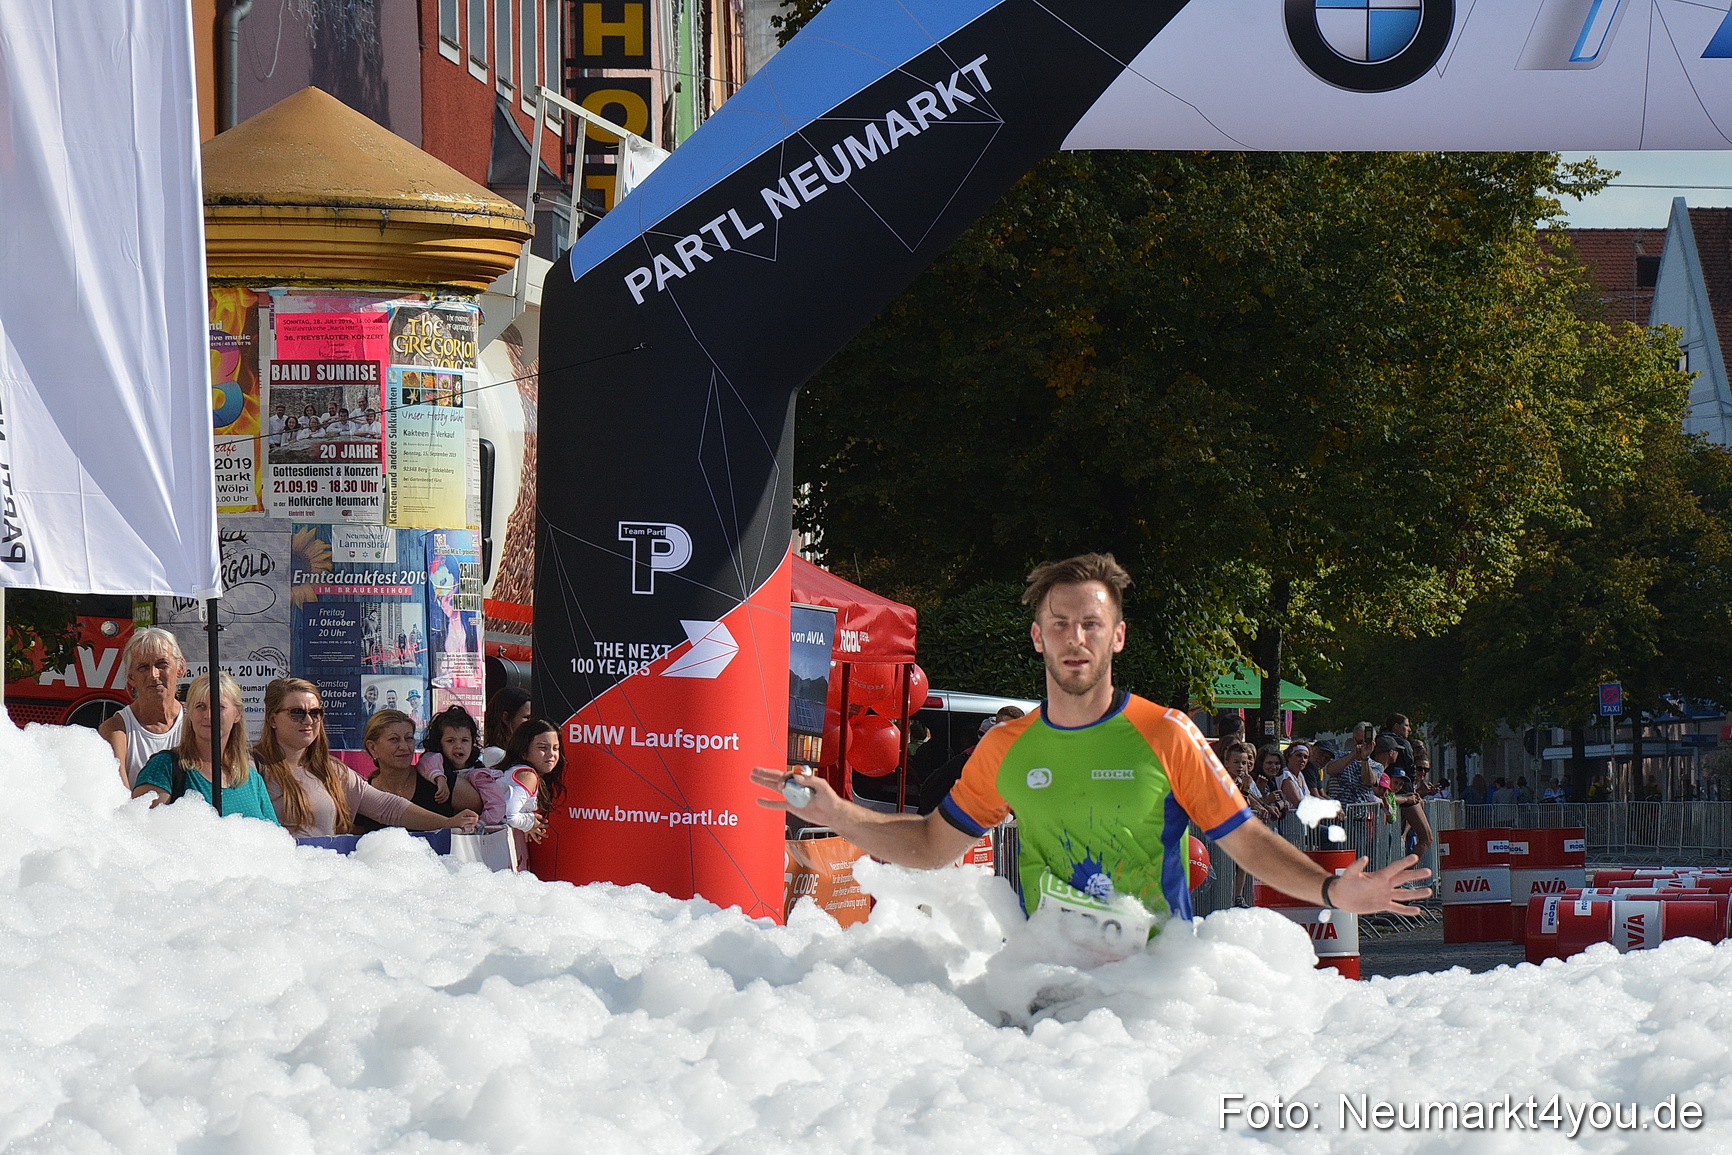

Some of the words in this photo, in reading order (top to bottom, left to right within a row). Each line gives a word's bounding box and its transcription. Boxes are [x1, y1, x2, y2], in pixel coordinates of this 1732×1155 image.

[624, 208, 765, 305] PARTL
[760, 53, 994, 220] NEUMARKT
[271, 364, 310, 381] BAND
[317, 364, 377, 381] SUNRISE
[388, 387, 398, 439] Sukkulenten
[403, 429, 429, 437] Kakteen
[320, 444, 334, 459] 20
[340, 444, 379, 459] JAHRE
[388, 441, 398, 469] andere
[215, 457, 252, 470] 2019
[273, 465, 334, 477] Gottesdienst
[336, 467, 341, 477] &
[344, 465, 379, 477] Konzert
[273, 480, 318, 493] 21.09.19
[329, 480, 358, 493] 18.30
[361, 480, 379, 493] Uhr
[388, 472, 398, 489] und
[217, 483, 249, 494] Wölpi
[288, 496, 333, 507] Hofkirche
[336, 496, 379, 507] Neumarkt
[388, 490, 398, 525] Kakteen
[345, 532, 384, 540] Neumarkter
[623, 527, 645, 535] Team
[339, 539, 390, 549] Lammsbräu
[293, 569, 398, 586] Erntedankfest
[400, 570, 427, 584] 2019
[338, 586, 409, 594] BRAUEREIHOF
[319, 608, 345, 618] Freitag
[309, 618, 318, 627] 11.
[320, 618, 356, 627] Oktober
[318, 629, 328, 637] 20
[331, 628, 346, 637] Uhr
[791, 631, 805, 643] von
[594, 641, 624, 658] THE
[628, 643, 672, 660] NEXT
[239, 665, 252, 677] 20
[256, 665, 277, 677] Uhr
[571, 658, 594, 674] 100
[597, 659, 651, 677] YEARS
[316, 680, 349, 689] Samstag
[321, 690, 357, 698] Oktober
[331, 700, 347, 708] Uhr
[1602, 705, 1620, 713] TAXI
[568, 723, 625, 746] BMW
[630, 726, 740, 753] Laufsport
[1091, 769, 1135, 780] BOCK
[568, 805, 739, 828] www.bmw-partl.de
[793, 873, 820, 895] CODE
[1302, 922, 1338, 940] VIA
[1623, 914, 1644, 949] VIA
